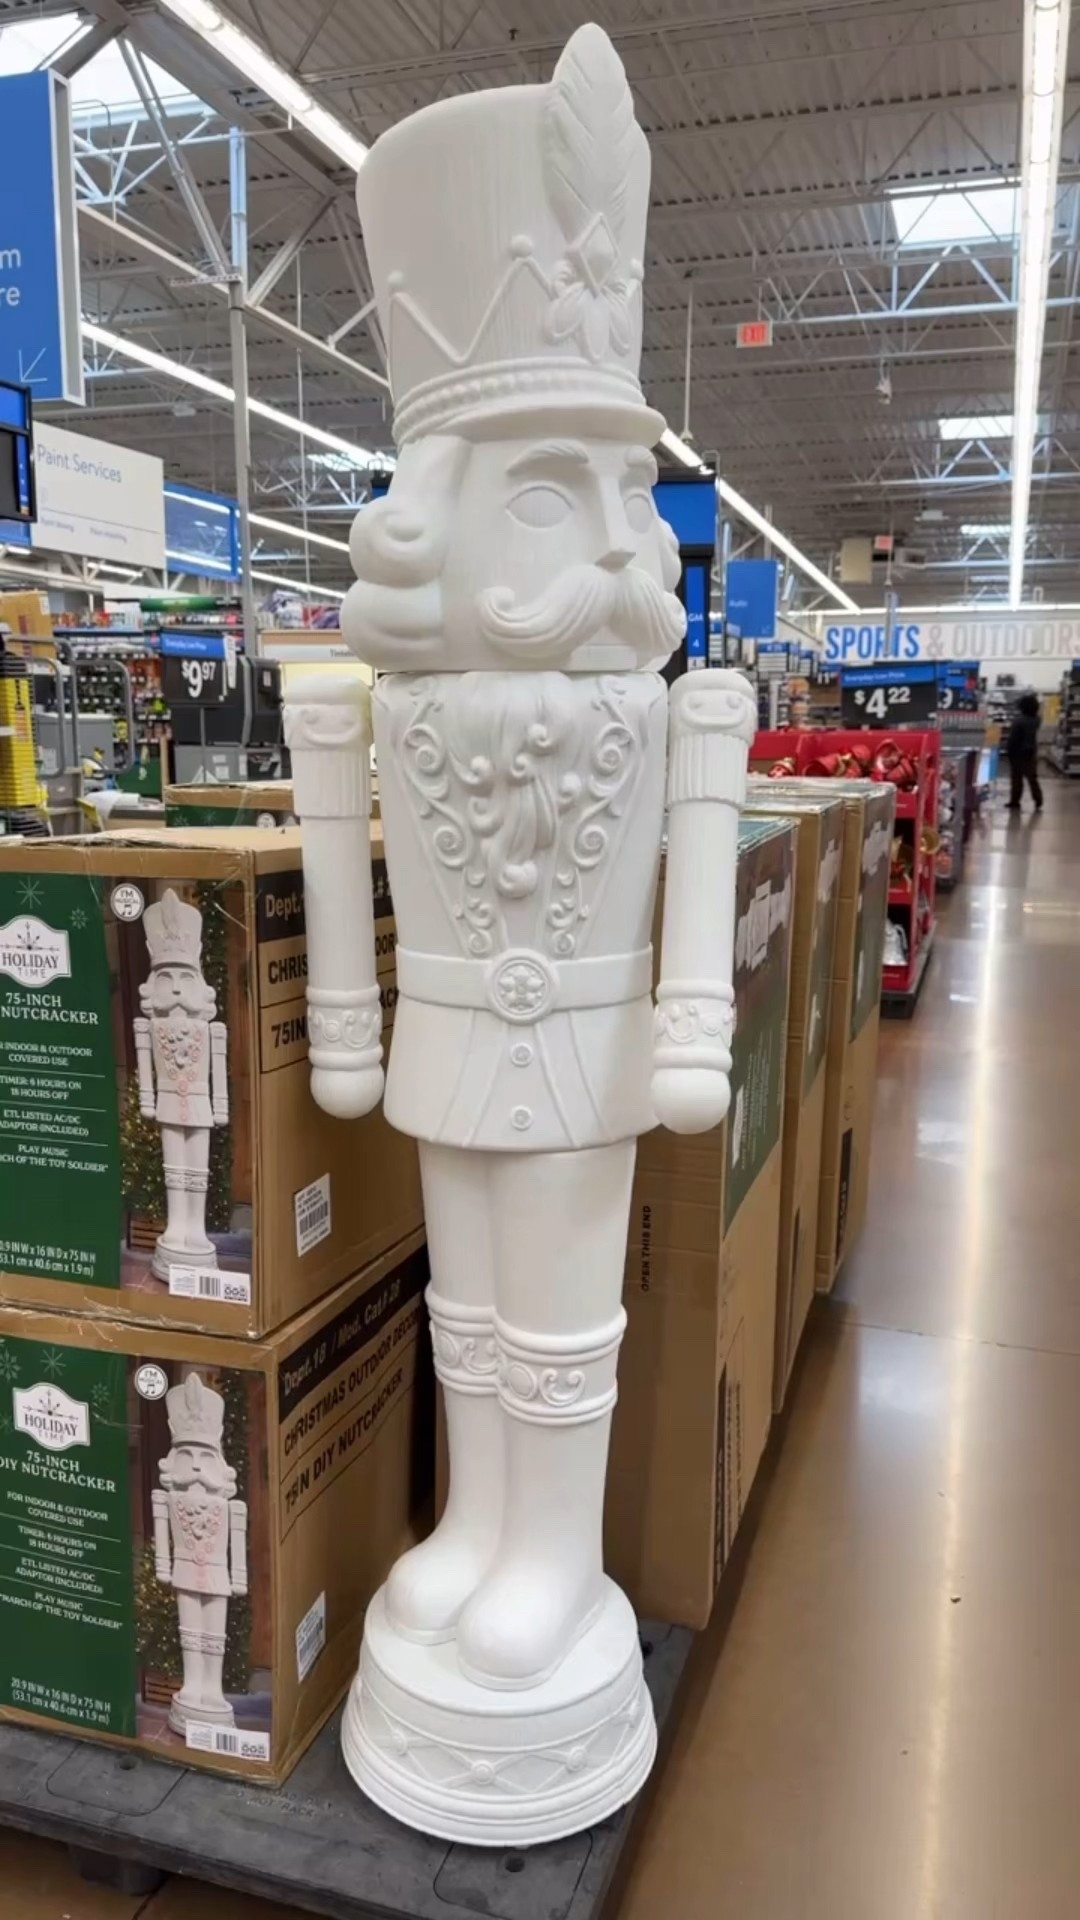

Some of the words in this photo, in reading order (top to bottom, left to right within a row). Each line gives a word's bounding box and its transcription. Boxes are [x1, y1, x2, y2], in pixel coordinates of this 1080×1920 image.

[37, 444, 69, 470] Paint
[73, 453, 122, 483] Services
[825, 624, 920, 660] SPORTS
[926, 625, 944, 658] &
[265, 893, 301, 921] Dept.
[2, 952, 59, 969] HOLIDAY
[17, 967, 46, 979] TIME
[5, 992, 62, 1008] 75-INCH
[0, 1005, 99, 1025] NUTCRACKER
[5, 1042, 39, 1052] INDOOR
[48, 1045, 93, 1057] OUTDOOR
[8, 1053, 50, 1065] COVERED
[51, 1056, 69, 1066] USE
[20, 1088, 51, 1099] HOURS
[51, 1091, 69, 1100] OFF
[37, 1078, 67, 1089] HOURS
[68, 1081, 82, 1090] ON
[3, 1109, 20, 1118] ETL
[21, 1110, 53, 1121] LISTED
[53, 1113, 81, 1125] AC/DC
[17, 1144, 40, 1154] PLAY
[41, 1147, 69, 1157] MUSIC
[15, 1155, 28, 1164] OF
[29, 1157, 47, 1167] THE
[47, 1159, 67, 1168] TOY
[641, 1205, 652, 1230] END
[36, 1245, 46, 1257] 16
[69, 1249, 79, 1261] 75
[641, 1231, 651, 1258] THIS
[16, 1256, 28, 1266] cm
[52, 1262, 64, 1272] cm
[641, 1260, 651, 1292] OPEN
[284, 1380, 346, 1457] CHRISTMAS
[348, 1334, 392, 1393] OUTDOOR
[24, 1413, 79, 1437] HOLIDAY
[313, 1442, 336, 1481] DIY
[338, 1367, 403, 1456] NUTCRACKER
[38, 1429, 66, 1444] TIME
[26, 1450, 80, 1473] 75-INCH
[21, 1462, 117, 1493] NUTCRACKER
[6, 1490, 24, 1502] FOR
[24, 1495, 56, 1511] INDOOR
[64, 1505, 109, 1522] OUTDOOR
[27, 1506, 67, 1523] COVERED
[67, 1516, 85, 1528] USE
[37, 1539, 67, 1556] HOURS
[66, 1546, 85, 1559] OFF
[52, 1533, 83, 1549] HOURS
[83, 1540, 97, 1551] ON
[15, 1566, 55, 1584] ADAPTOR
[21, 1556, 38, 1570] ETL
[38, 1560, 68, 1576] LISTED
[68, 1568, 96, 1582] AC/DC
[32, 1600, 44, 1611] OF
[44, 1603, 62, 1617] THE
[63, 1609, 82, 1622] TOY
[34, 1591, 55, 1604] PLAY
[56, 1596, 84, 1612] MUSIC
[31, 1696, 43, 1707] cm
[66, 1705, 79, 1717] cm
[51, 1687, 61, 1700] 16
[83, 1696, 94, 1709] 75
